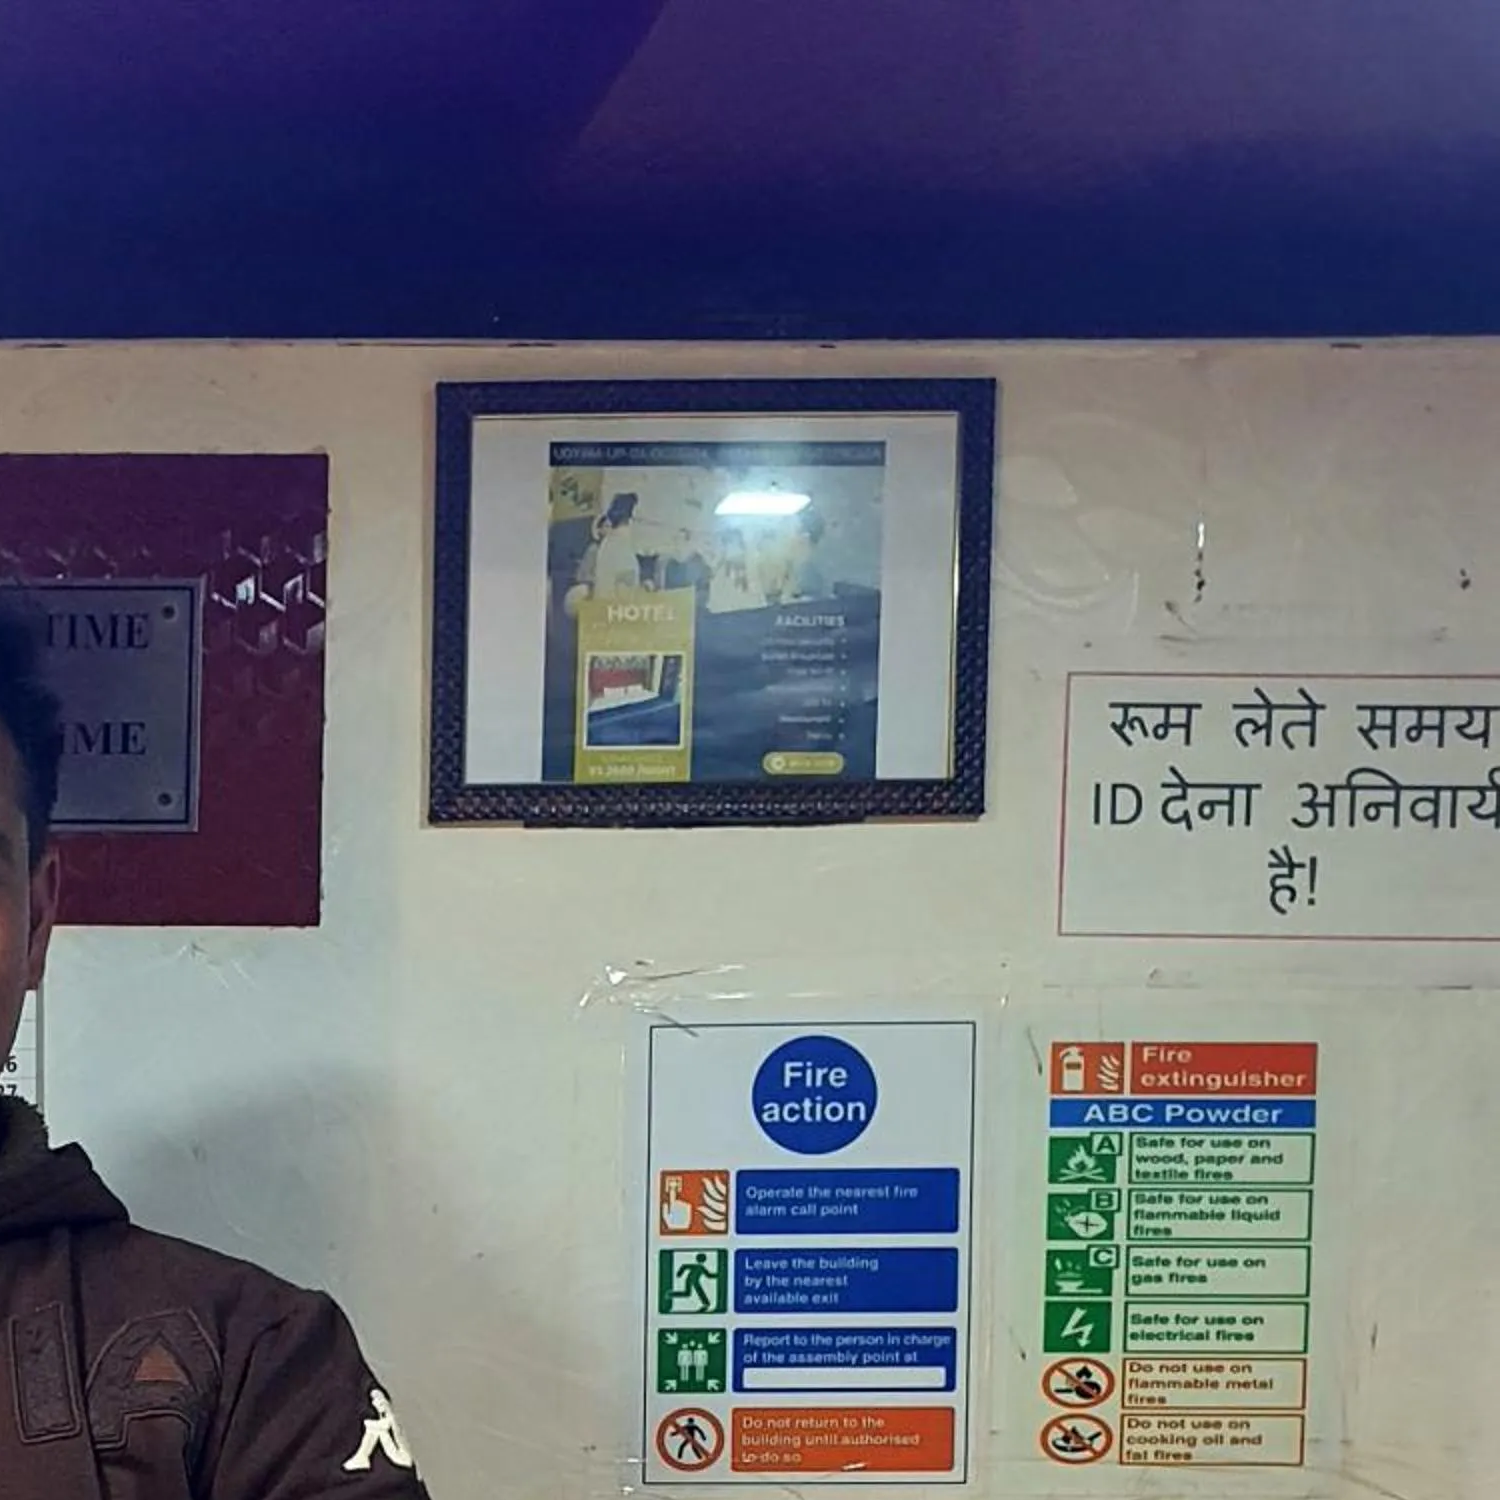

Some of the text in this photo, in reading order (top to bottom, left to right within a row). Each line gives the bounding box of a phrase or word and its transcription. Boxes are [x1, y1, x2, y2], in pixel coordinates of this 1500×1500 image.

[606, 604, 677, 622] HOTEL
[774, 615, 845, 627] FACILITIES
[1108, 687, 1500, 750] रूम लेते समय
[1093, 782, 1143, 826] ID
[1161, 765, 1262, 831] देना
[1267, 845, 1318, 915] है!
[1142, 1046, 1192, 1063] Fire
[783, 1061, 848, 1089] Fire
[1140, 1070, 1308, 1091] extinguisher
[761, 1096, 867, 1122] action
[1084, 1103, 1283, 1123] ABC Powder
[1097, 1135, 1116, 1152] A
[1135, 1135, 1271, 1149] Safe for use on
[1135, 1152, 1284, 1168] wood, paper and
[1134, 1168, 1234, 1181] textile fires
[745, 1184, 919, 1201] Operate the nearest fire
[1094, 1191, 1115, 1208] B
[1135, 1193, 1269, 1205] Safe for use on
[745, 1203, 859, 1218] alarm call point
[1133, 1208, 1281, 1223] flammable liquid
[1133, 1225, 1173, 1237] fires
[745, 1257, 879, 1272] Leave the building
[1093, 1249, 1114, 1265] C
[1131, 1255, 1266, 1268] Safe for use on
[744, 1275, 848, 1288] by the nearest
[1131, 1271, 1208, 1286] gas fires
[744, 1292, 839, 1305] available exit
[1130, 1313, 1264, 1326] Safe for use on
[743, 1332, 951, 1348] Report to the person in charge
[1129, 1329, 1255, 1342] electrical fires
[743, 1351, 758, 1363] of
[762, 1351, 785, 1363] the
[788, 1351, 857, 1365] assembly
[863, 1351, 900, 1364] point
[1129, 1362, 1253, 1374] Do not use on
[1128, 1377, 1274, 1390] flammable metal
[1127, 1393, 1167, 1405] fires
[742, 1416, 885, 1429] Do not return to the
[1127, 1418, 1251, 1430] Do not use on
[741, 1433, 920, 1448] building until authorised
[1126, 1434, 1263, 1446] cooking oil and
[783, 1453, 802, 1463] so
[1153, 1449, 1194, 1461] fires
